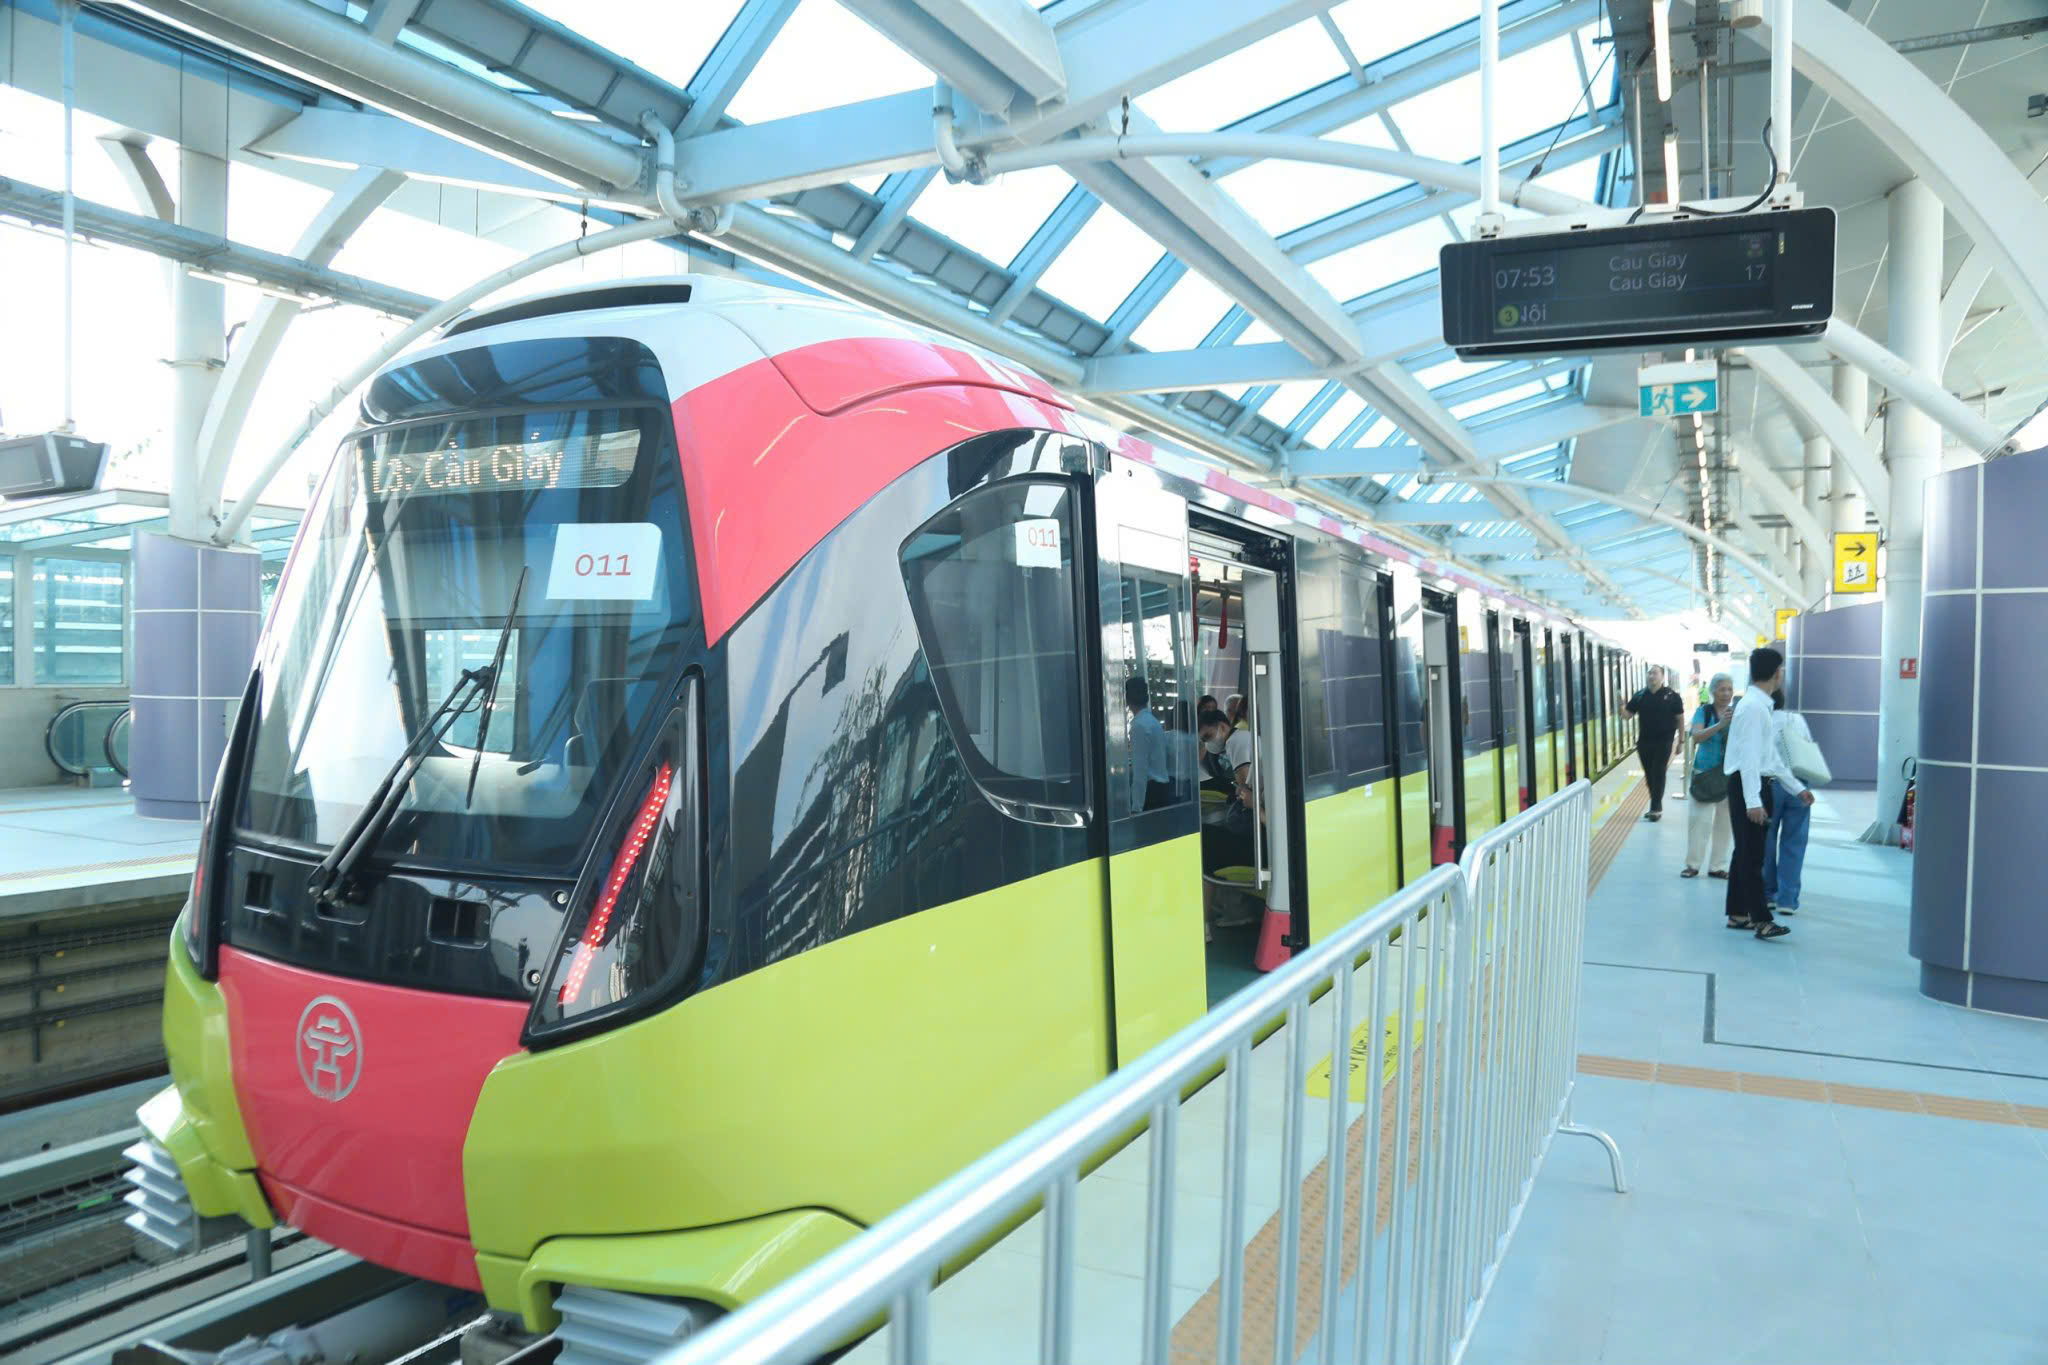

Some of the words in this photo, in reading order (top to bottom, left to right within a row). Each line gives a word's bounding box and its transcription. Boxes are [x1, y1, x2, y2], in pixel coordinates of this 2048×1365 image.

[1609, 256, 1642, 272] Cau
[1648, 252, 1687, 271] Giay
[1745, 264, 1766, 281] 17
[1496, 266, 1554, 289] 07:53
[1609, 276, 1642, 291] Cau
[1648, 272, 1687, 291] Giay
[425, 439, 480, 489] Cầu
[1028, 527, 1057, 548] 011
[575, 553, 632, 577] 011
